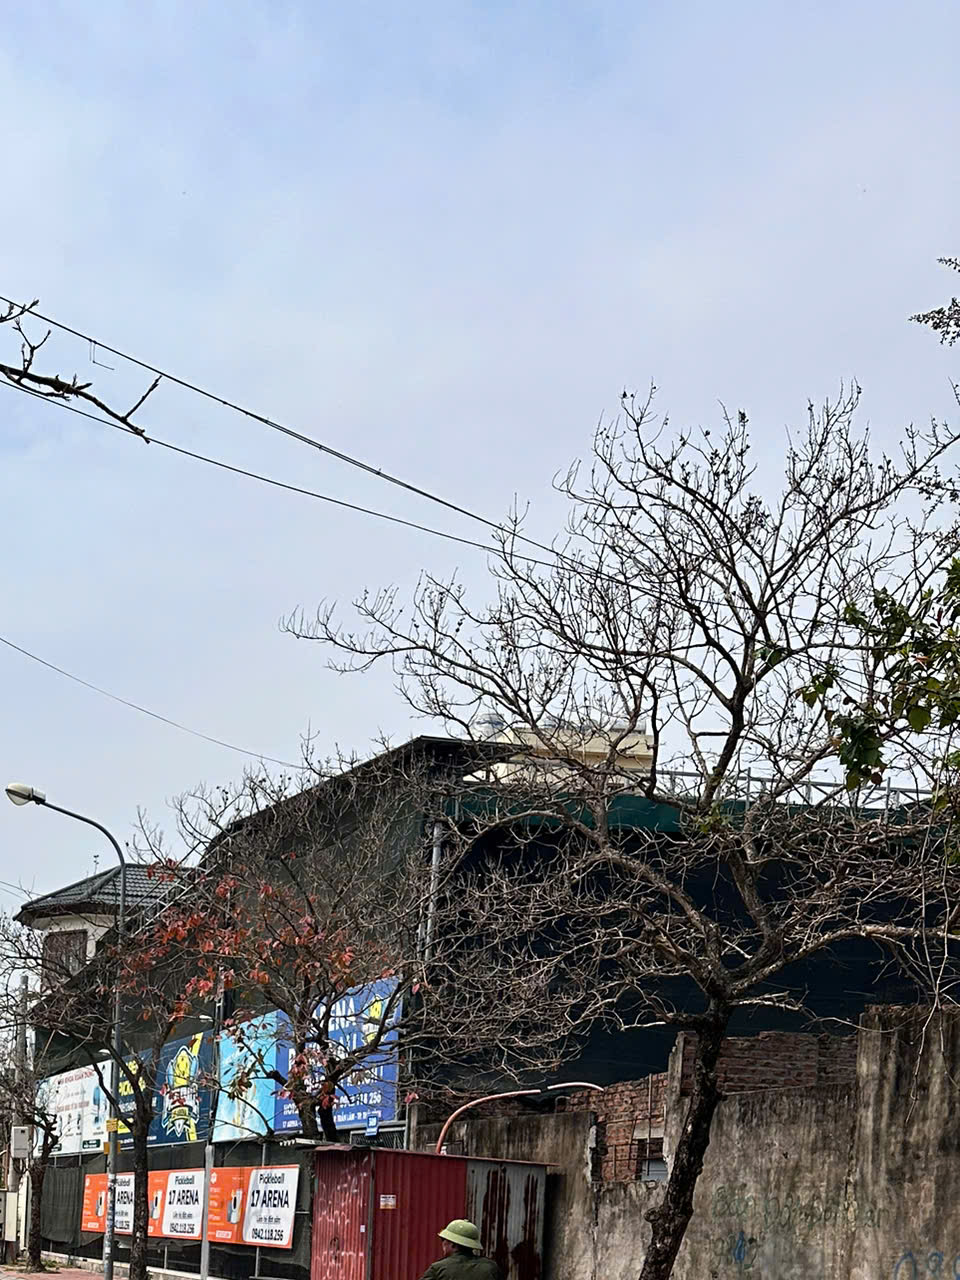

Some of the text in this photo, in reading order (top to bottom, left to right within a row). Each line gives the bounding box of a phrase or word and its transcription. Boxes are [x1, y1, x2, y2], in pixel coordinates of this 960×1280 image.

[259, 1173, 285, 1185] Pickleball
[169, 1190, 200, 1206] 17 ARENA
[251, 1190, 290, 1209] 17 ARENA
